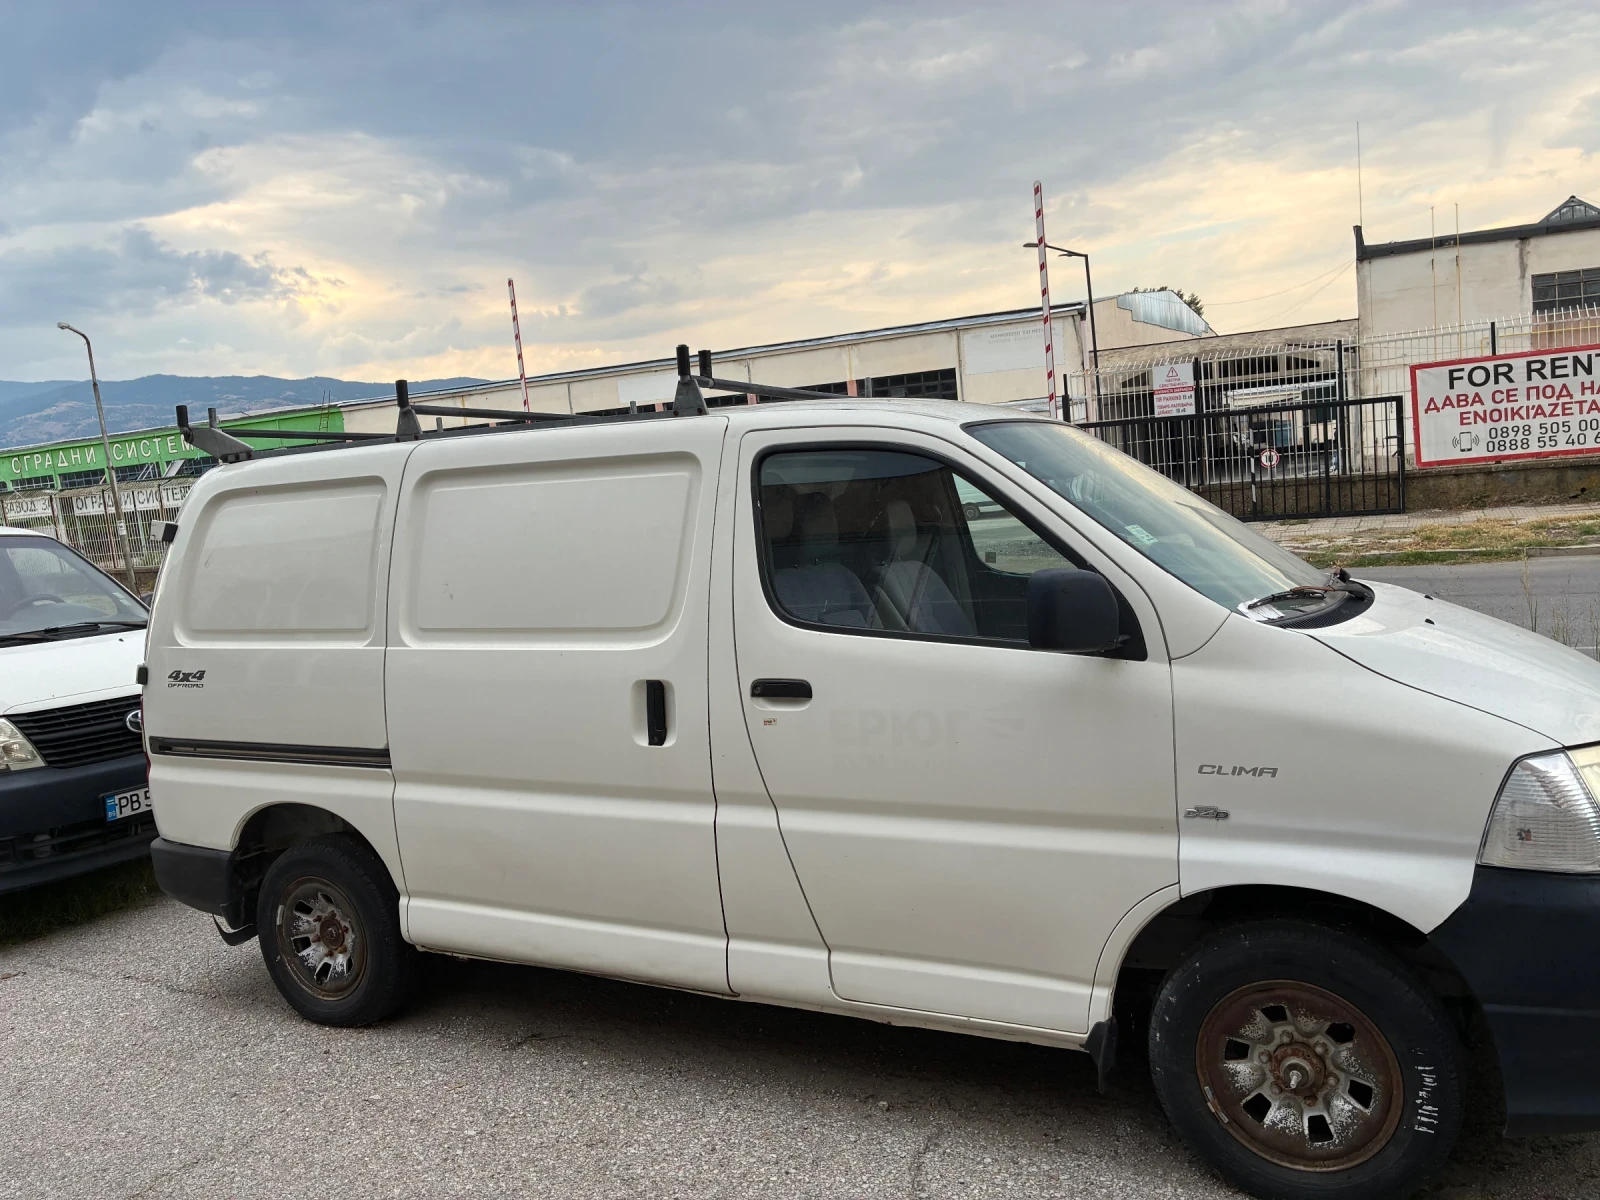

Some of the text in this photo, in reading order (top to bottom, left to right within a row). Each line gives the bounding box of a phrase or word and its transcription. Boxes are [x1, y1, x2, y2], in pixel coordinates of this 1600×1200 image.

[1449, 363, 1515, 390] FOR
[1425, 392, 1485, 414] ДАВА
[1491, 388, 1519, 405] СЕ
[1526, 383, 1574, 401] ПОД
[1489, 424, 1532, 440] 0898
[1539, 421, 1571, 435] 505
[1486, 437, 1530, 453] 0888
[1537, 435, 1558, 449] 55
[1565, 432, 1587, 446] 40
[11, 446, 96, 473] ОГРАДНИ
[168, 670, 206, 682] 4x4
[1198, 764, 1279, 778] CLIMA
